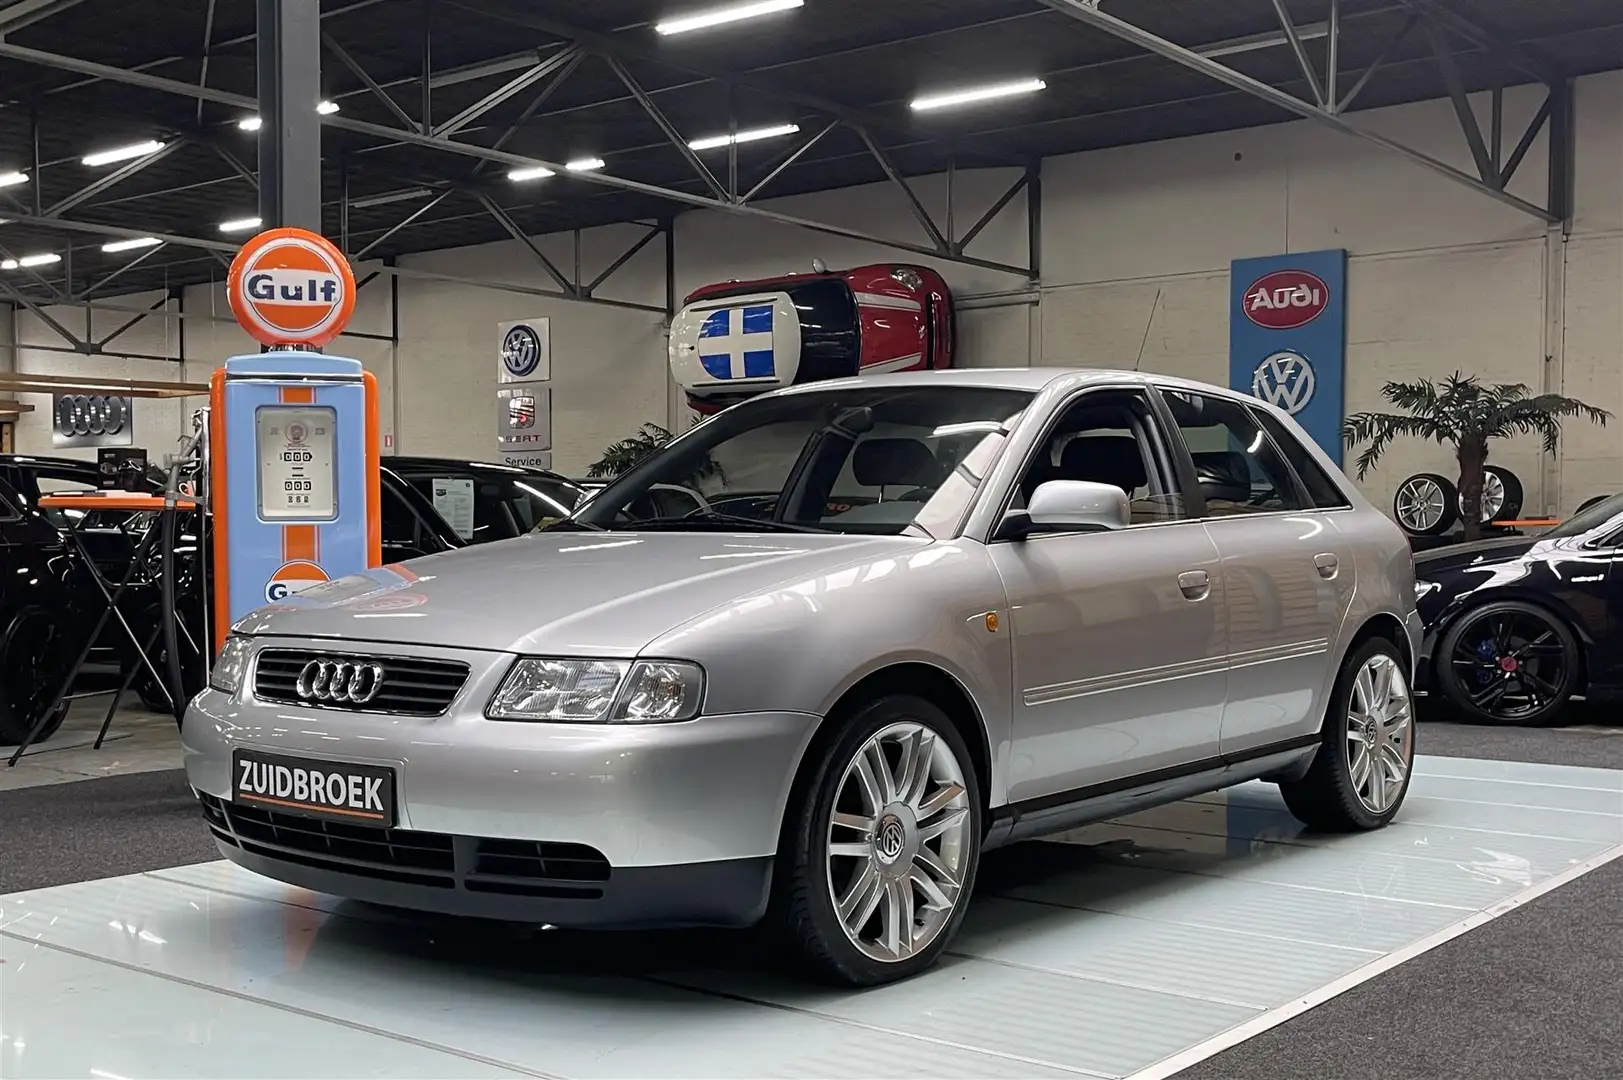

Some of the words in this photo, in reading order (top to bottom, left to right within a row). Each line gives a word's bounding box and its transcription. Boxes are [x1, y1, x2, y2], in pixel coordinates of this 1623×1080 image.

[248, 274, 336, 301] Gulf
[505, 434, 541, 443] SEAT
[505, 457, 542, 466] Service
[239, 760, 384, 811] ZUIDBROEK
